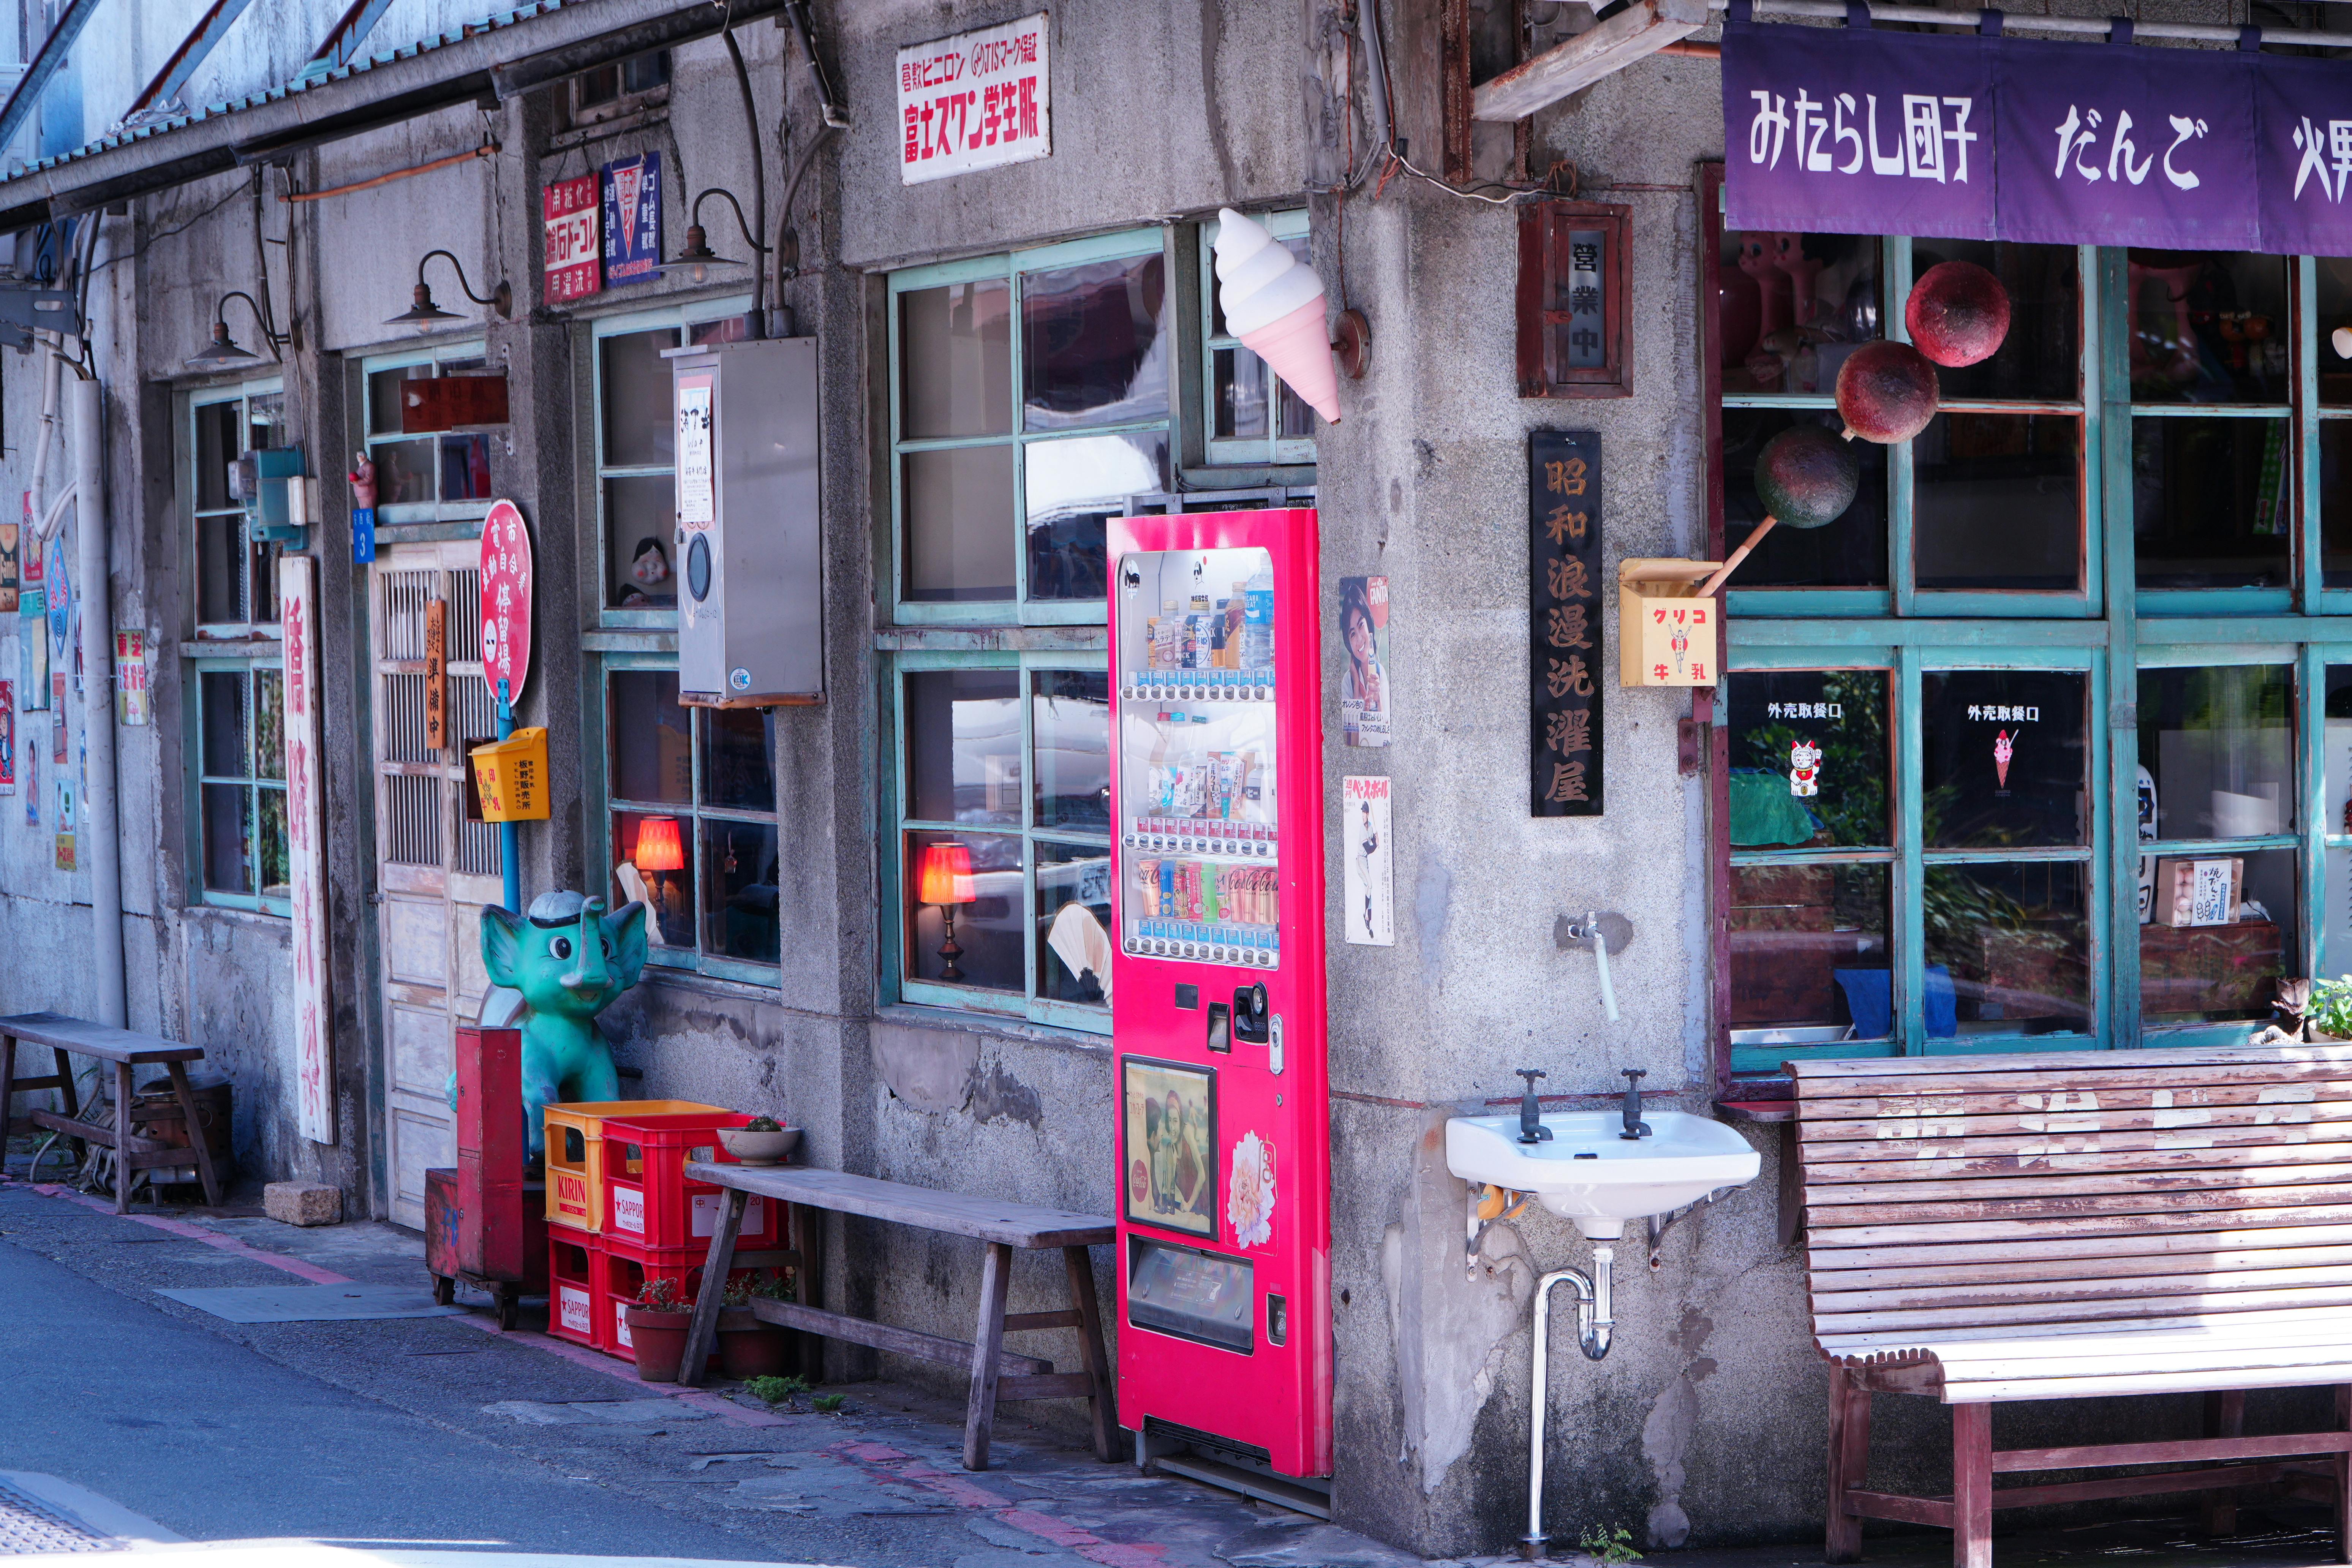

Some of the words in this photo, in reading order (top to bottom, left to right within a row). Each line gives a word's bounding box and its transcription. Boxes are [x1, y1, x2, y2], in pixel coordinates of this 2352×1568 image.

[904, 75, 1038, 164] 富士スワン学生服
[1750, 89, 1977, 185] みたらし団子
[2055, 104, 2208, 192] だんご
[552, 269, 583, 296] 洗濯用
[360, 533, 365, 557] 3
[1653, 608, 1706, 624] グリコ
[496, 581, 511, 677] 停留場
[1545, 458, 1593, 803] 昭和浪漫洗濯屋
[117, 633, 142, 657] 東芝
[1654, 664, 1706, 680] 牛乳
[428, 657, 439, 739] 準備中
[1342, 700, 1363, 709] オレンジ色の
[1767, 702, 1841, 720] 外売取餐口
[1968, 705, 2039, 722] 外売取餐口
[519, 760, 531, 810] 板野販売所
[1345, 780, 1352, 798] 週刊
[1353, 780, 1388, 799] ベースボール
[2208, 867, 2224, 901] 焼だんご
[558, 1175, 586, 1204] KIRIN
[750, 1197, 760, 1205] 20
[696, 1199, 704, 1208] 中
[623, 1220, 636, 1228] サッポロビール
[568, 1319, 582, 1328] サッポロビール
